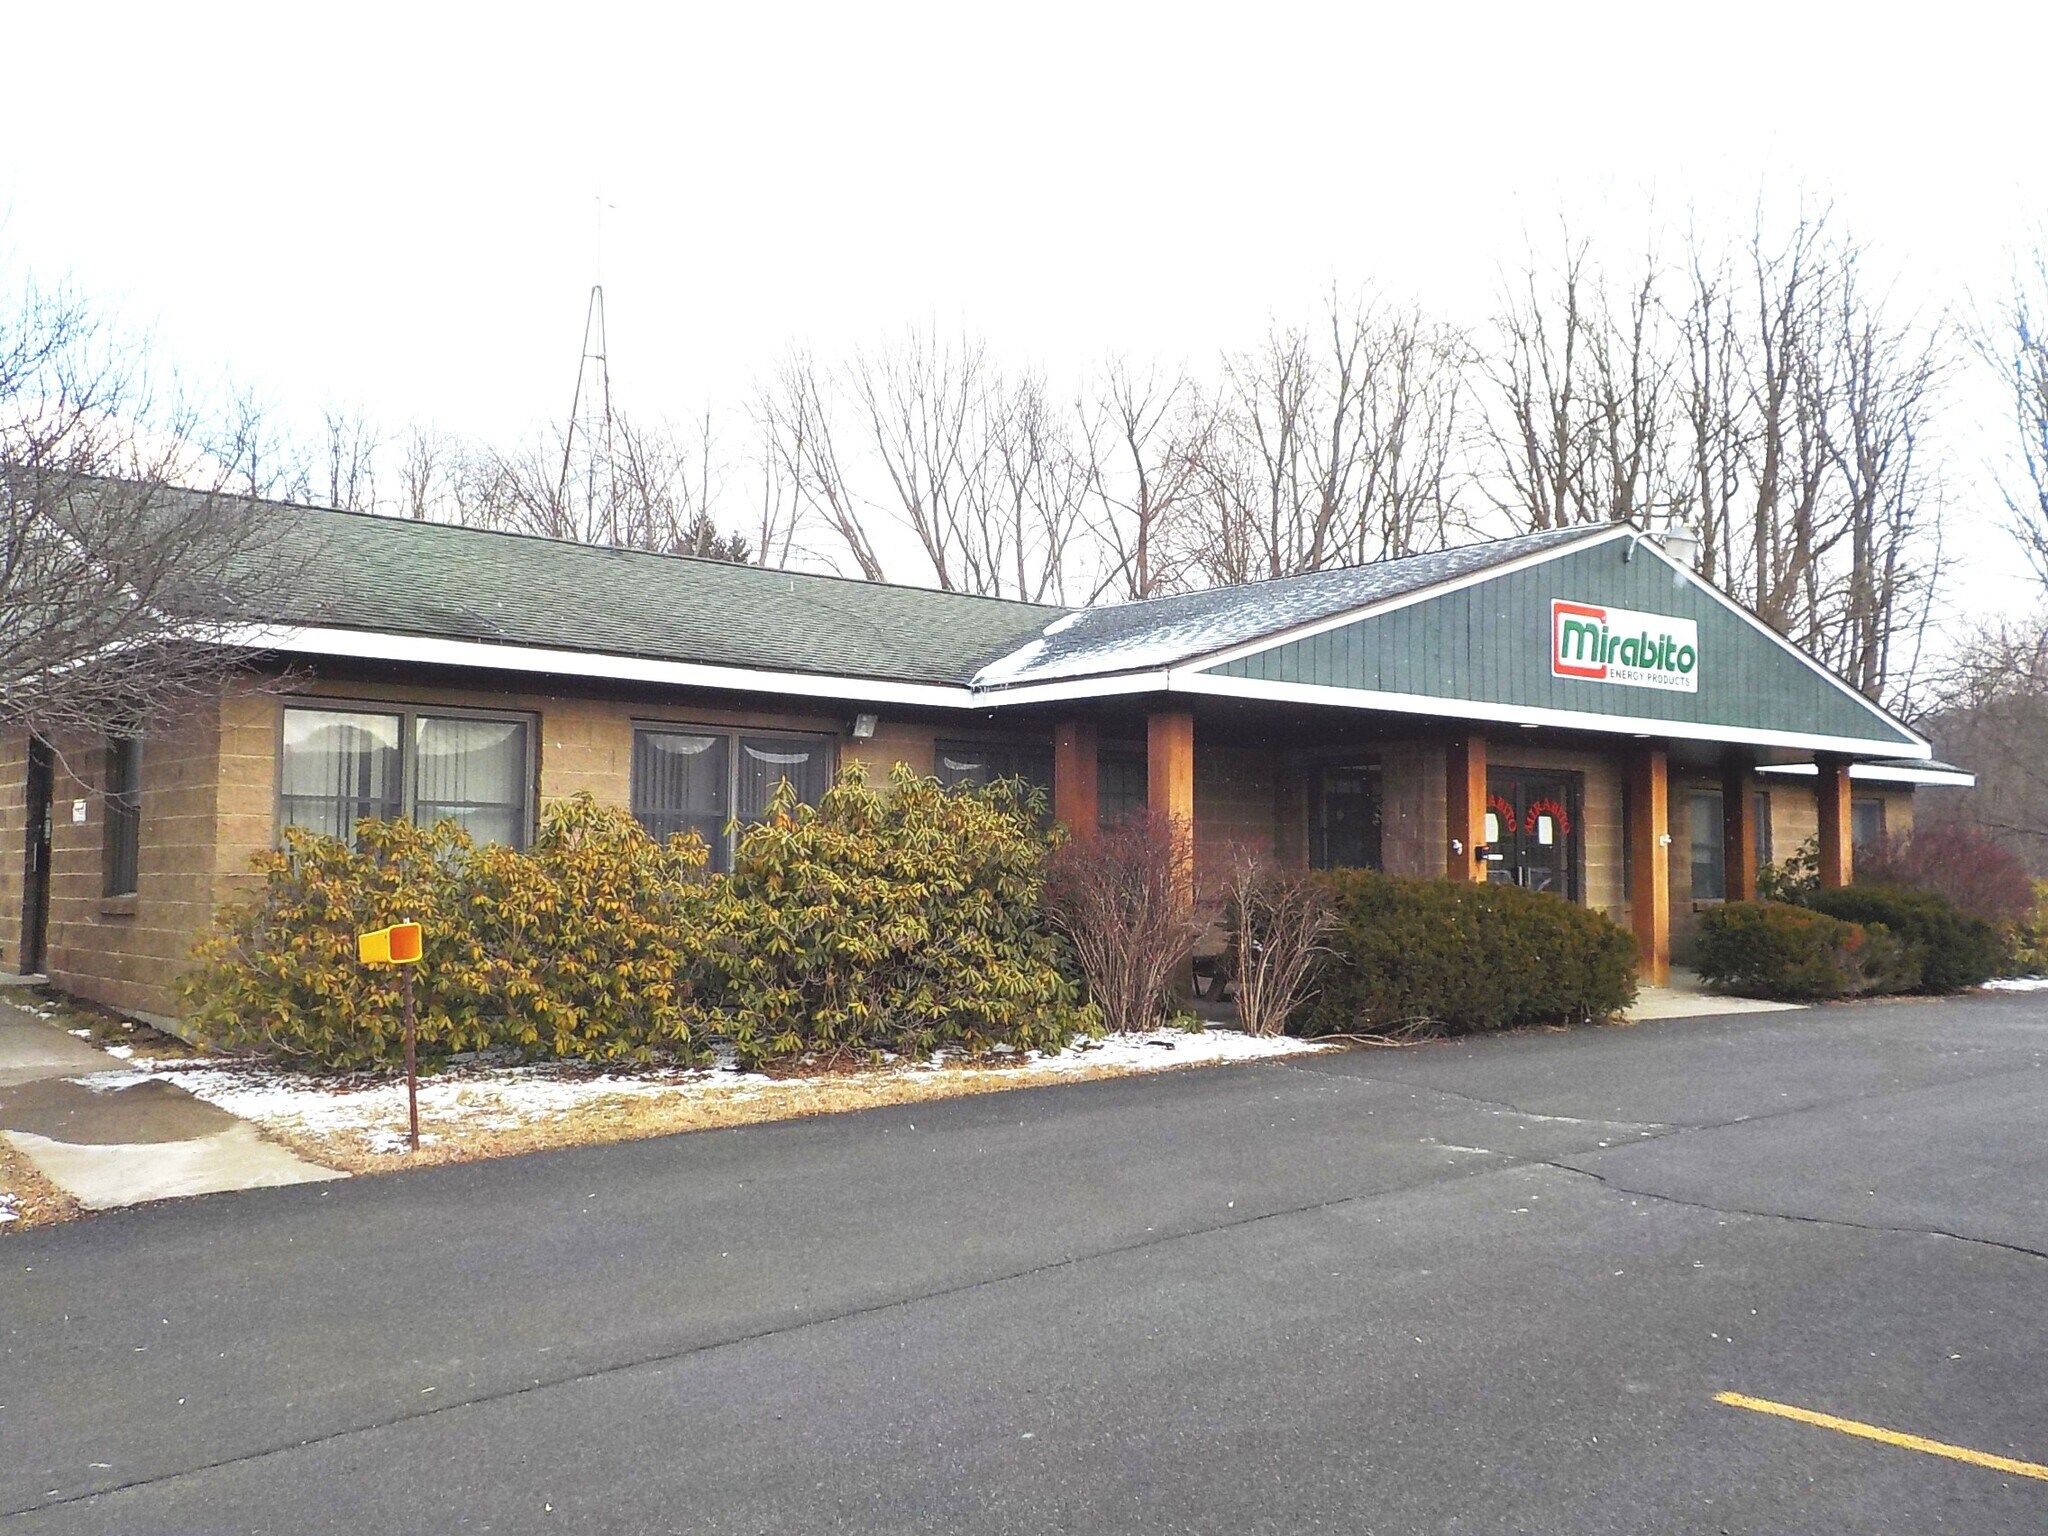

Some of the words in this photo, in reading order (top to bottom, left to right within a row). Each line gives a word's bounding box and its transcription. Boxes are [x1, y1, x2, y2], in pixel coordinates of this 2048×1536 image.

[1561, 619, 1696, 674] mirabito
[1610, 668, 1644, 681] ENERGY
[1647, 673, 1691, 687] PRODUCTS
